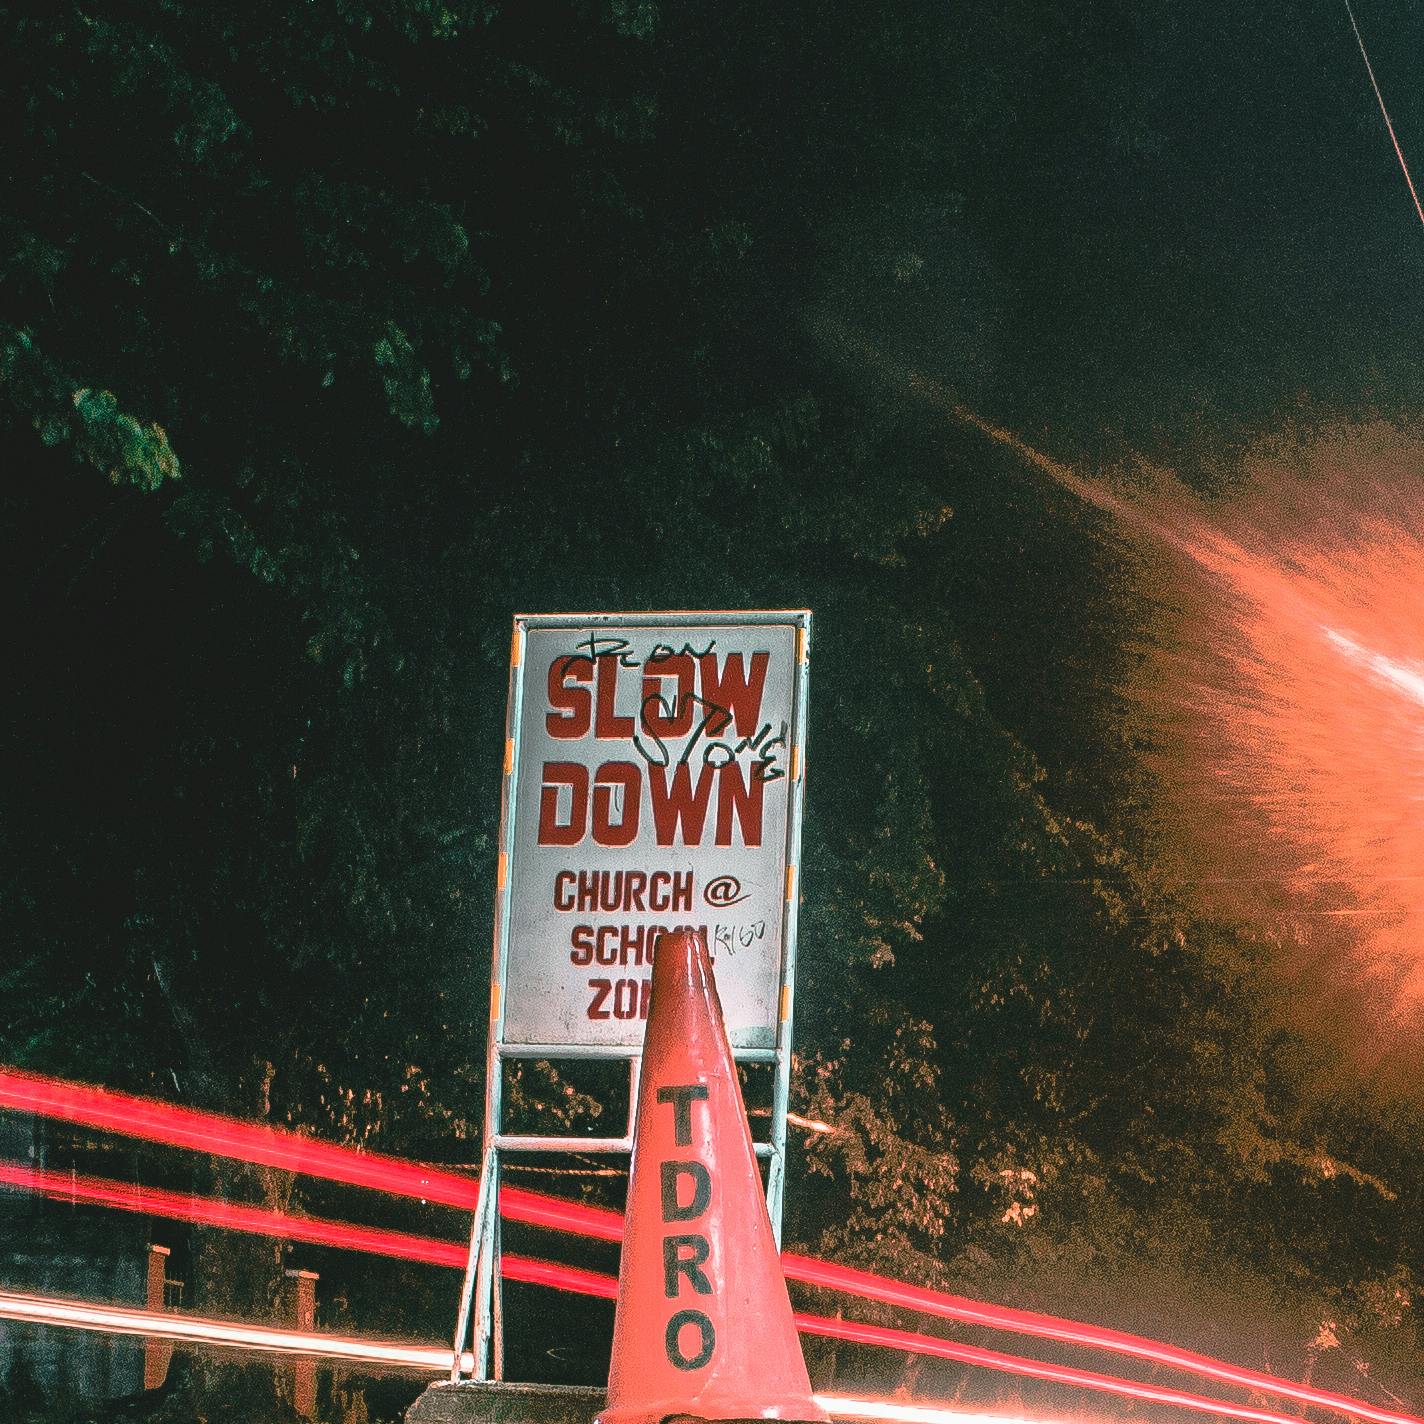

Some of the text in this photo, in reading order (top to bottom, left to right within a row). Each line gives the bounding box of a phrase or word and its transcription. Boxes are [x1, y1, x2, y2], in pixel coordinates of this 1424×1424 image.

[545, 651, 770, 739] SLOW
[537, 760, 763, 847] DOWN
[554, 870, 752, 912] CHURCH @
[657, 1085, 716, 1371] TDRO
